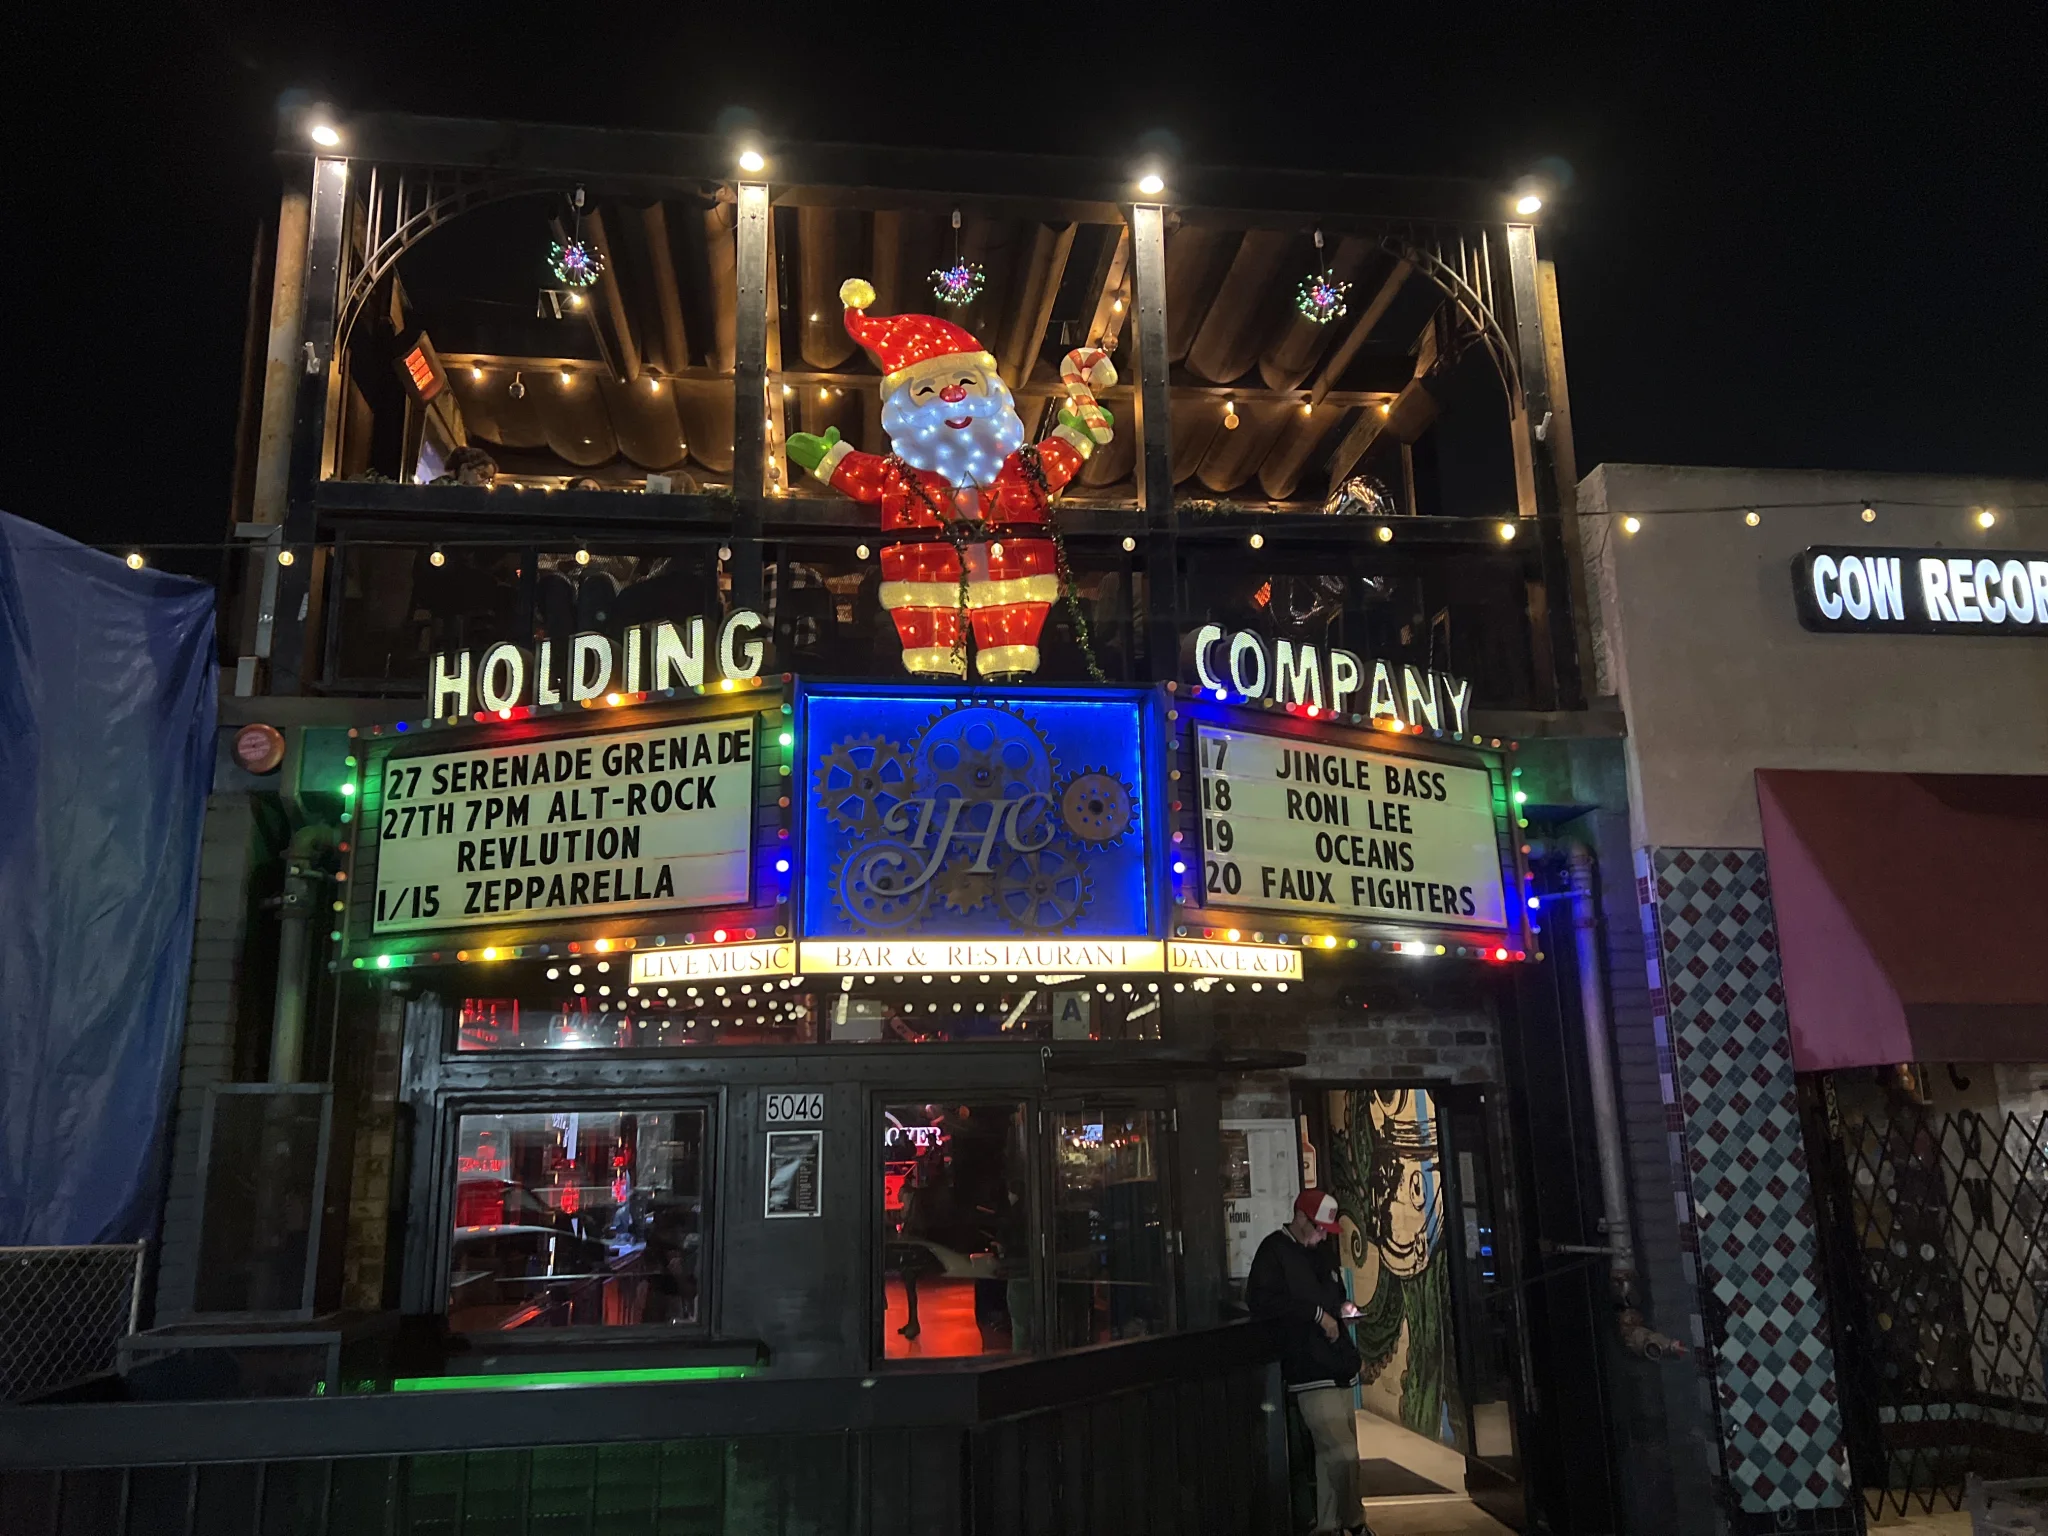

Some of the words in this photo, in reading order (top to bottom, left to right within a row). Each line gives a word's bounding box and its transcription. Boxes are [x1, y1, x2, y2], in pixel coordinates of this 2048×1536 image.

[1813, 554, 1905, 621] COW
[431, 608, 767, 720] HOLDING
[1194, 624, 1469, 734] COMPANY
[388, 765, 422, 801] 27
[431, 747, 593, 796] SERENADE
[601, 728, 752, 777] GRENADE
[1199, 736, 1229, 771] 17
[1275, 748, 1372, 792] JINGLE
[1384, 766, 1448, 802] BASS
[382, 801, 455, 841] 27TH
[465, 794, 530, 833] 7PM
[546, 775, 718, 825] ALT-ROCK
[1202, 778, 1233, 812] 18
[1285, 787, 1350, 827] RONI
[1367, 799, 1414, 835] LEE
[456, 825, 641, 874] REVLUTION
[1204, 818, 1235, 853] 19
[1314, 831, 1416, 873] OCEANS
[376, 884, 440, 923] 1/15
[463, 863, 676, 915] ZEPPARELLA
[1206, 860, 1243, 895] 20
[1260, 865, 1336, 905] FAUX
[1351, 877, 1477, 917] FIGHTERS
[643, 954, 699, 978] LIVE
[707, 946, 790, 974] MUSIC
[835, 946, 892, 967] BAR
[906, 946, 928, 966] &
[948, 945, 1128, 967] RESTAURANT
[1172, 946, 1247, 971] DANCE
[1253, 953, 1268, 972] &
[1275, 953, 1297, 974] DJ
[1061, 998, 1082, 1021] A
[767, 1095, 823, 1120] 5046
